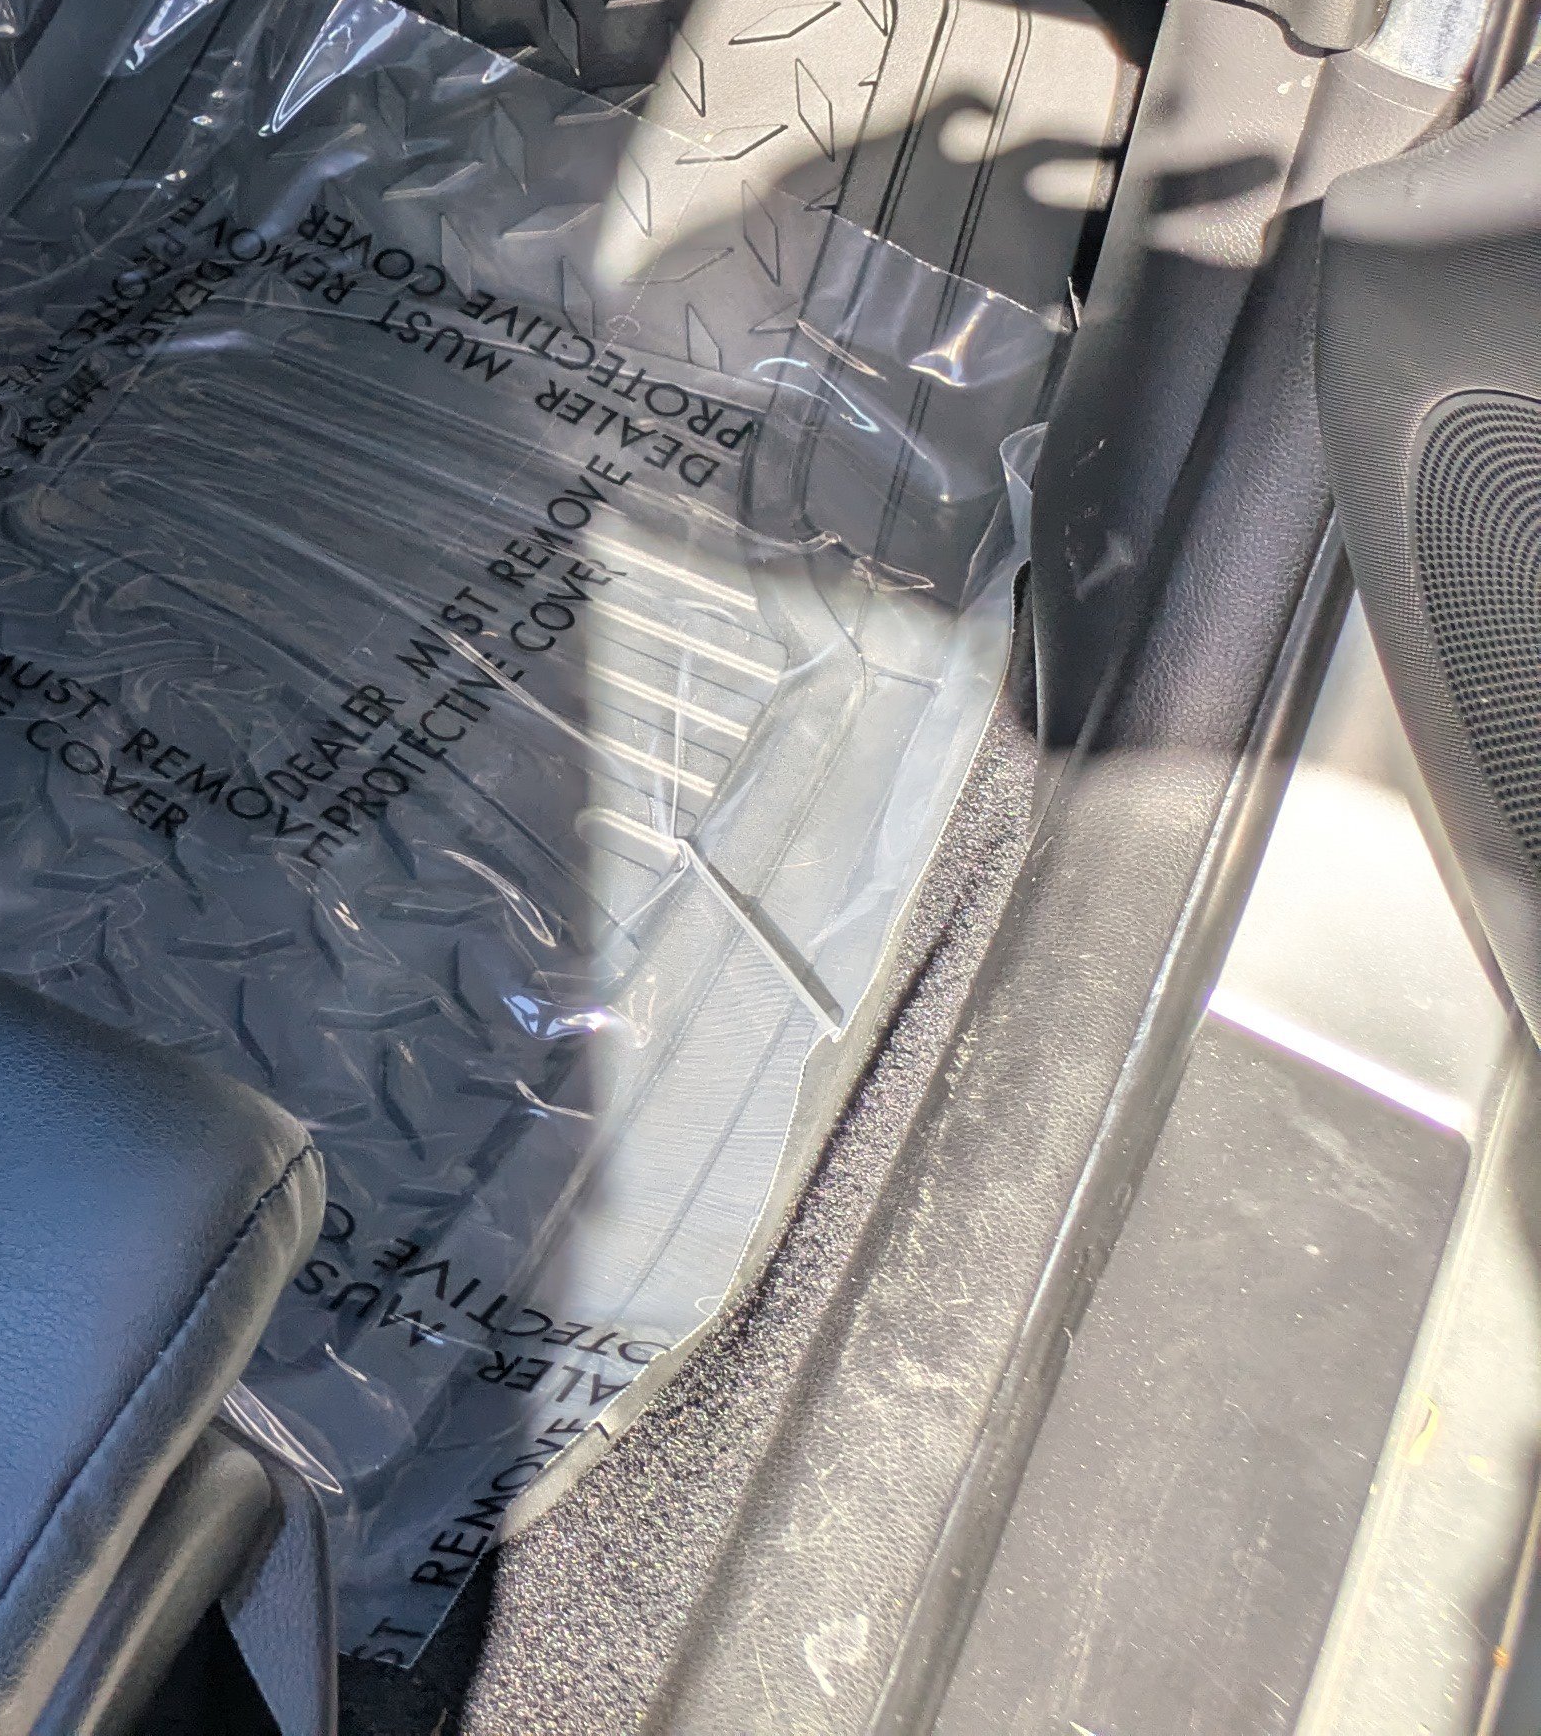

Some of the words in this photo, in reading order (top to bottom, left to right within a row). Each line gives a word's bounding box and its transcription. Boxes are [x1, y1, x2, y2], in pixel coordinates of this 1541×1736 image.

[178, 195, 358, 305] REMOVE
[299, 203, 446, 297] COVER
[370, 299, 514, 382] MUST
[459, 291, 758, 453] PROTECTIVE
[534, 379, 722, 487] DEALER
[266, 684, 406, 803] DEALER
[487, 453, 633, 589] REMOVE
[25, 719, 190, 841] COVER
[121, 727, 344, 869] REMOVE
[320, 650, 526, 837] PROTECTIVE
[293, 1258, 446, 1348] MUS
[373, 1236, 672, 1366] OTECTIVE
[479, 1350, 634, 1407] ALER
